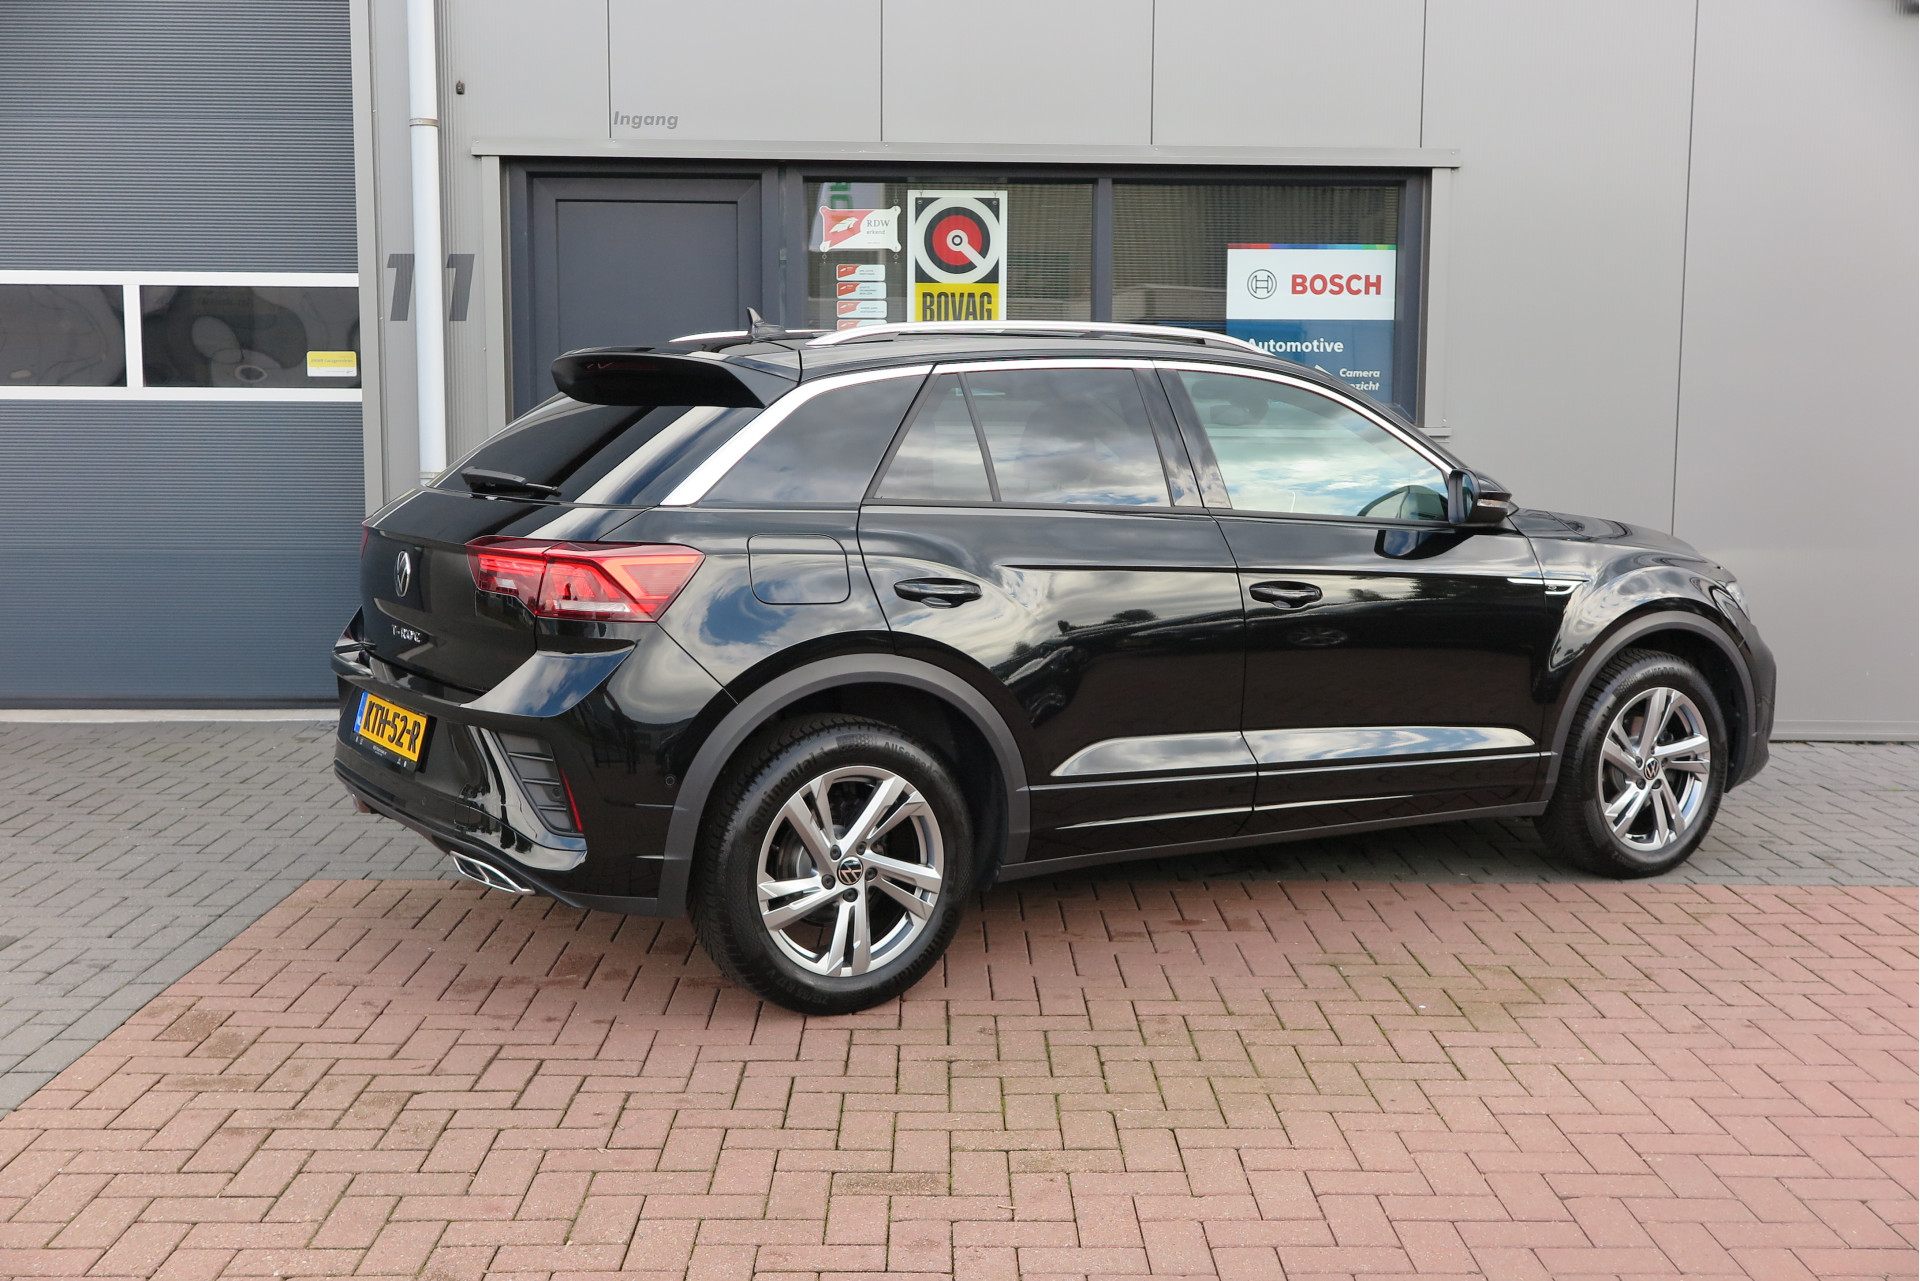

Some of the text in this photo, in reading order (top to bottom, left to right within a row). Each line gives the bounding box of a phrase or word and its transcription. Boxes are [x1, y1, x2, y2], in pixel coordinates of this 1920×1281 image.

[613, 111, 679, 129] Ingang
[866, 219, 891, 227] RDW
[387, 253, 475, 321] 11
[1291, 273, 1382, 295] BOSCH
[922, 291, 993, 321] BOVAG
[1339, 368, 1380, 378] Camera
[363, 700, 421, 754] KTH-52-R
